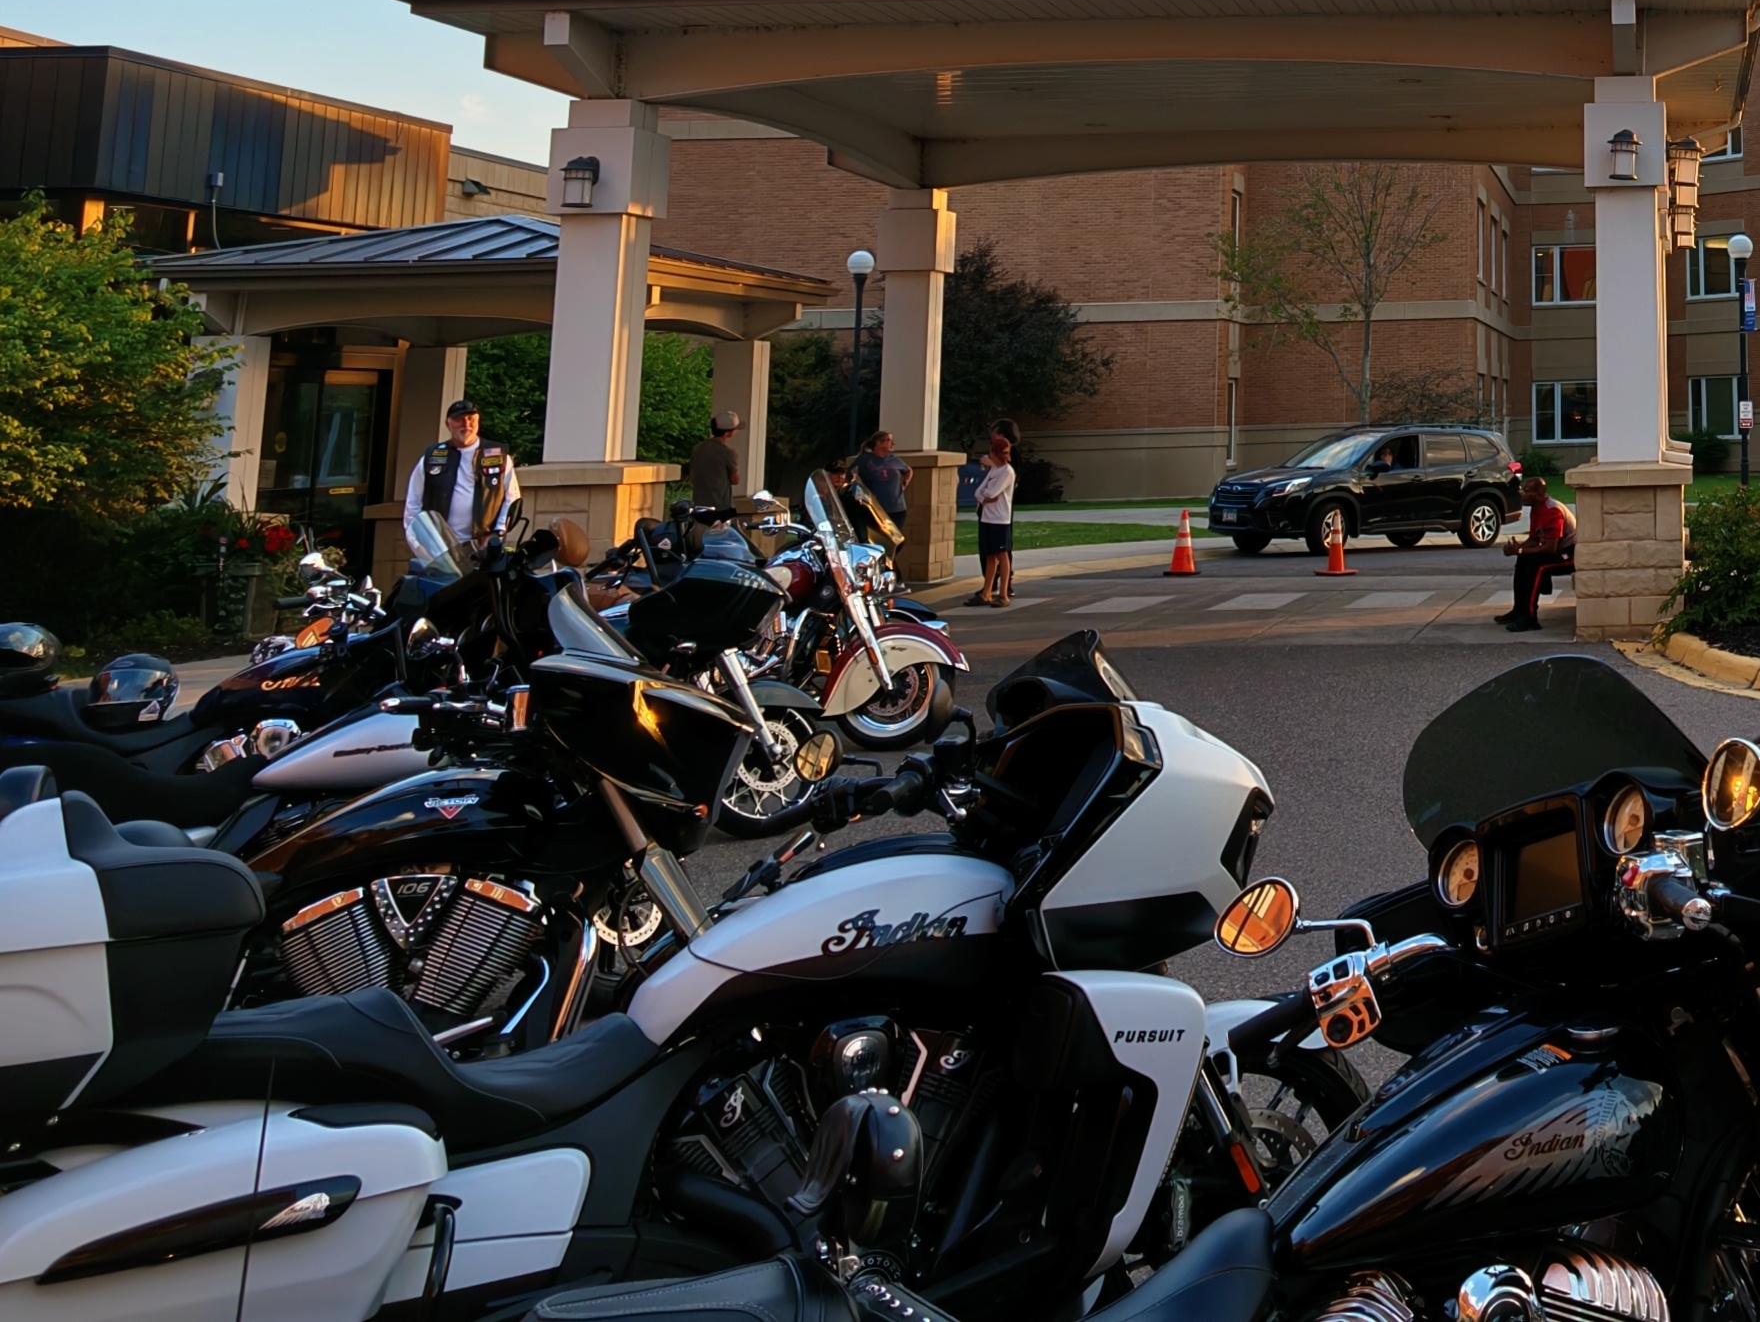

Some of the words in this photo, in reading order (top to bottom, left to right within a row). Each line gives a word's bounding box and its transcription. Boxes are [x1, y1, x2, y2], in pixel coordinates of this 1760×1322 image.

[397, 882, 431, 895] 106
[821, 909, 968, 957] Indian
[1113, 1029, 1186, 1044] PURSUIT
[1503, 1132, 1585, 1161] Indian
